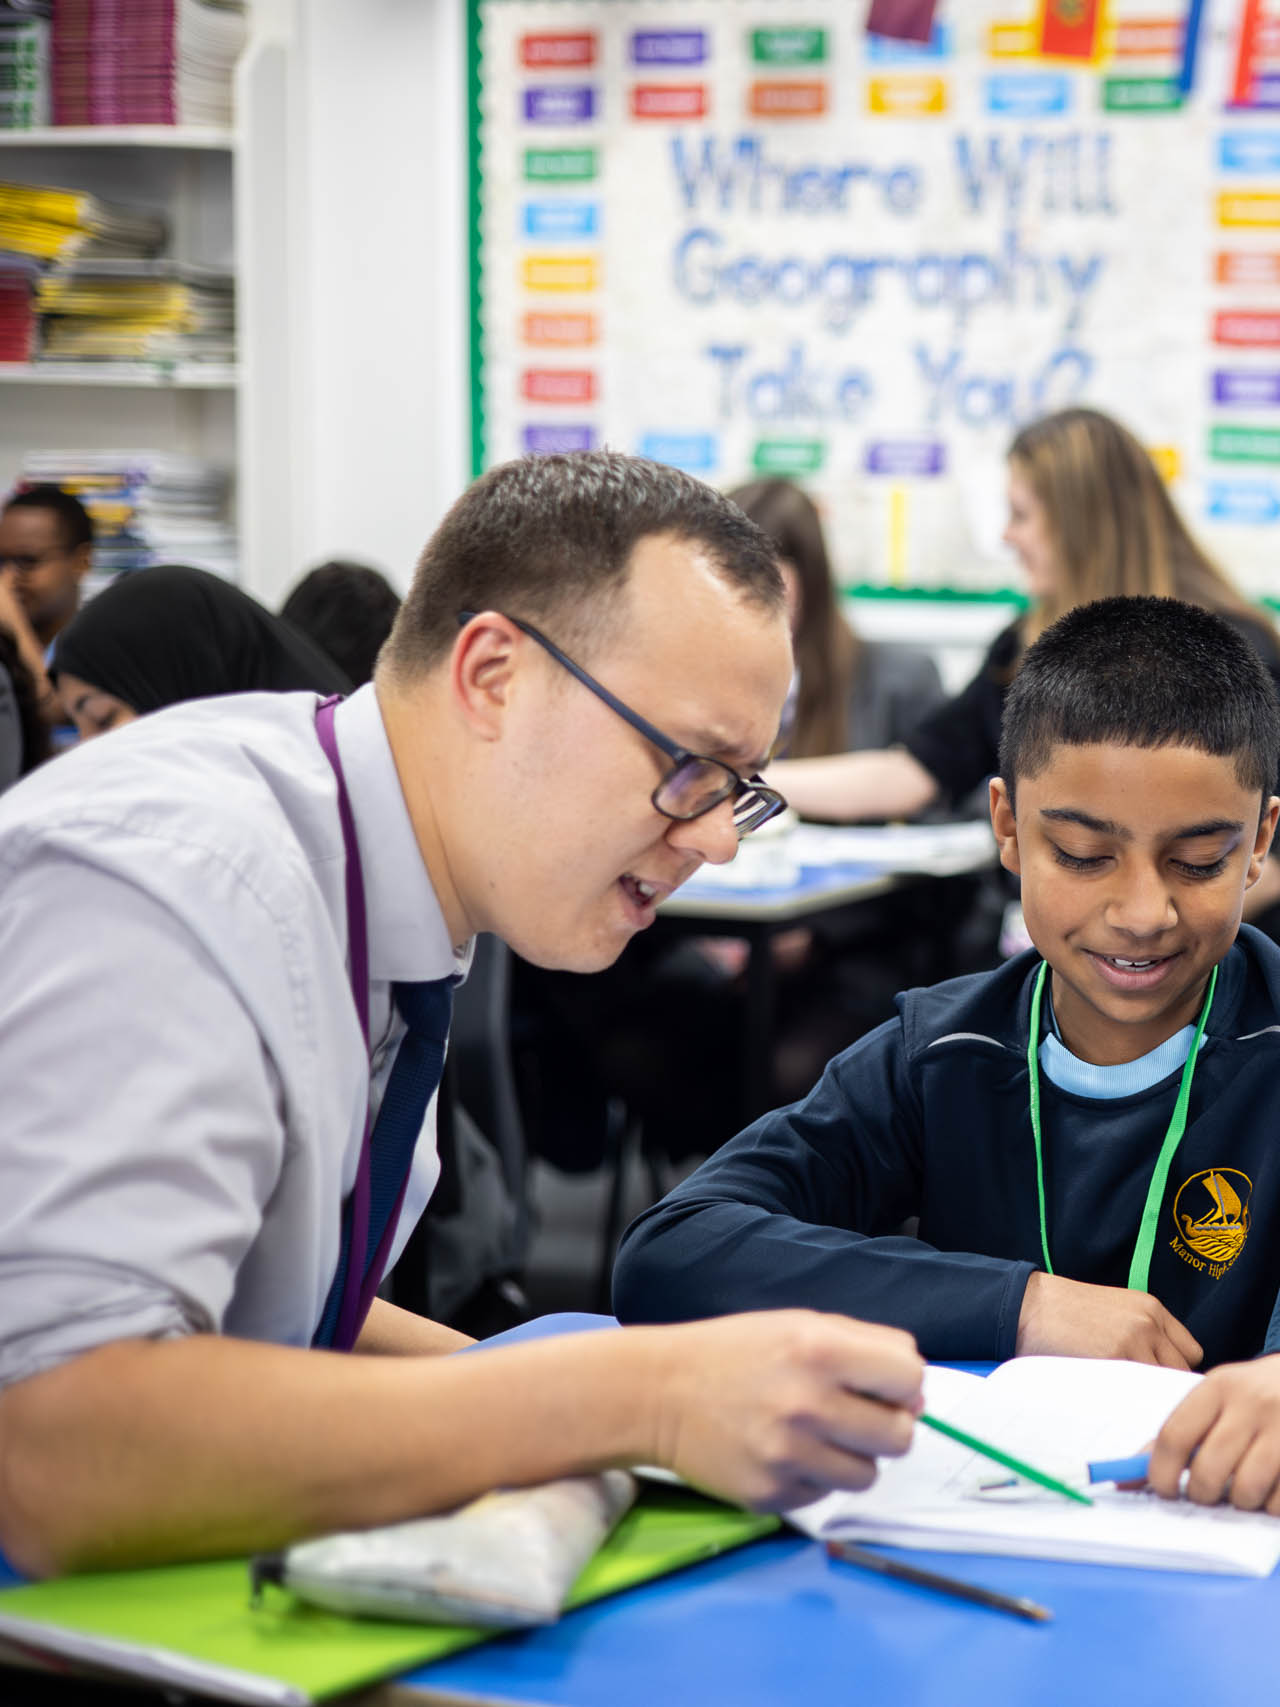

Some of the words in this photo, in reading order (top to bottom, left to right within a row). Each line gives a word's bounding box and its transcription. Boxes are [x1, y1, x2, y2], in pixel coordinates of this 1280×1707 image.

[670, 133, 920, 214] Where
[953, 133, 1117, 214] Will
[673, 227, 1105, 340] Geography
[706, 342, 870, 421] Take
[1169, 1236, 1206, 1271] Manor
